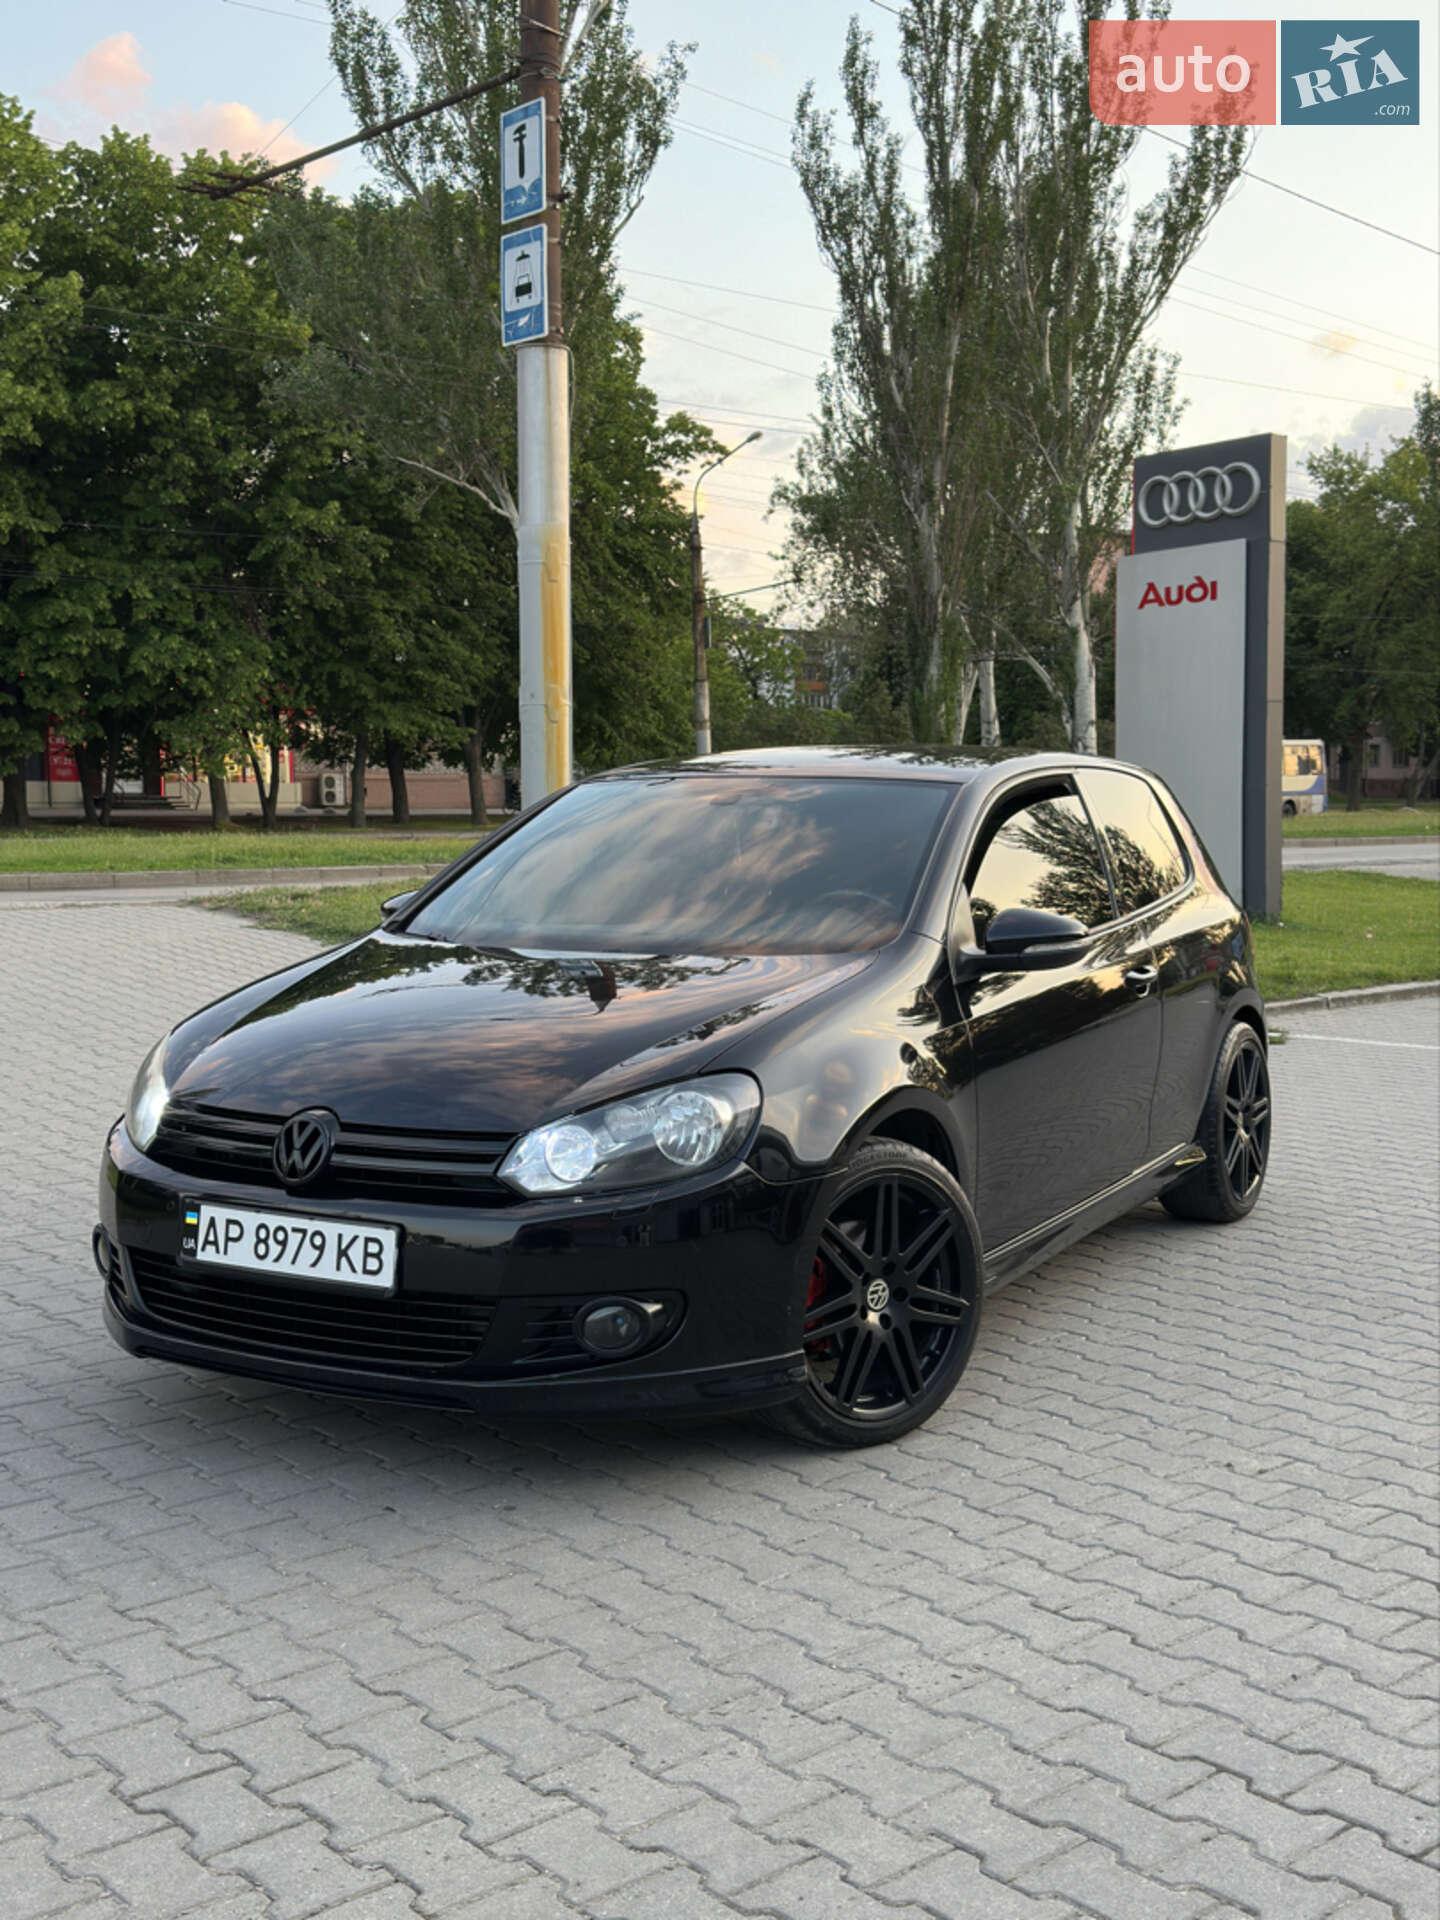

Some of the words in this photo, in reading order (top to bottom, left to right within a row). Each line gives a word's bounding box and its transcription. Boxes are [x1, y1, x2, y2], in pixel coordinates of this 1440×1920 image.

[1137, 575, 1218, 611] Audi
[182, 1236, 197, 1250] UA
[200, 1215, 245, 1256] AP
[253, 1222, 327, 1268] 8979
[335, 1232, 385, 1277] KB
